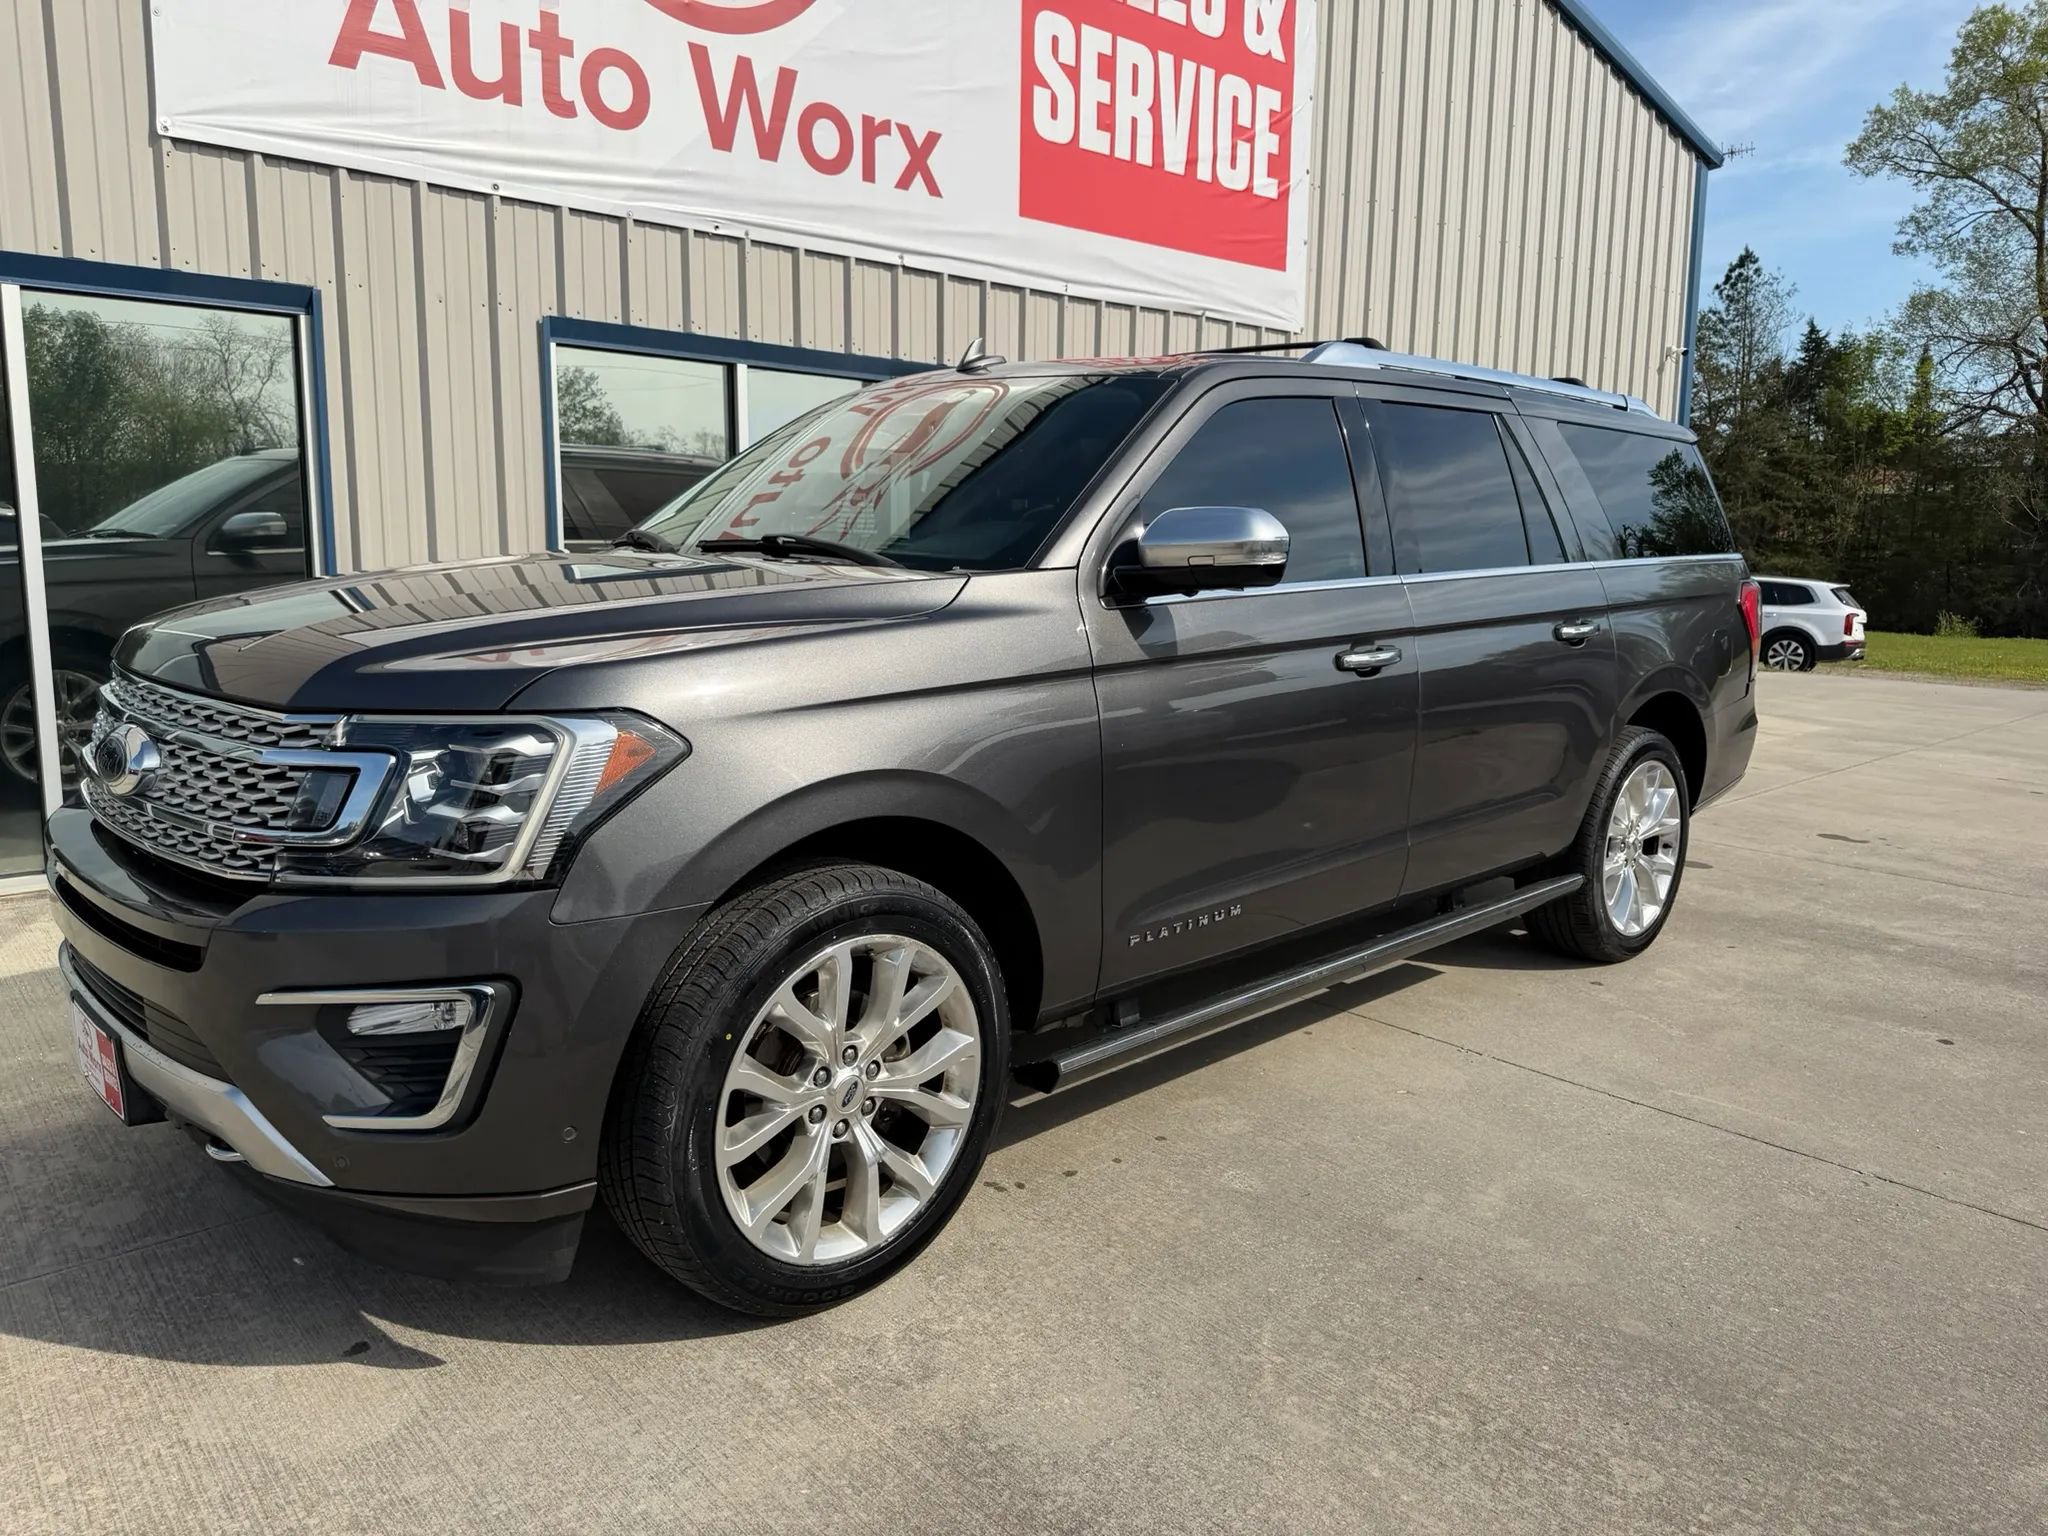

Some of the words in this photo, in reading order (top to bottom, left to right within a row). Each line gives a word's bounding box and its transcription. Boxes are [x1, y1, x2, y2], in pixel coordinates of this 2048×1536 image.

[328, 0, 651, 131] Auto
[687, 41, 944, 199] Worx
[1032, 9, 1282, 200] SERVICE
[1128, 904, 1241, 947] PLATINUM
